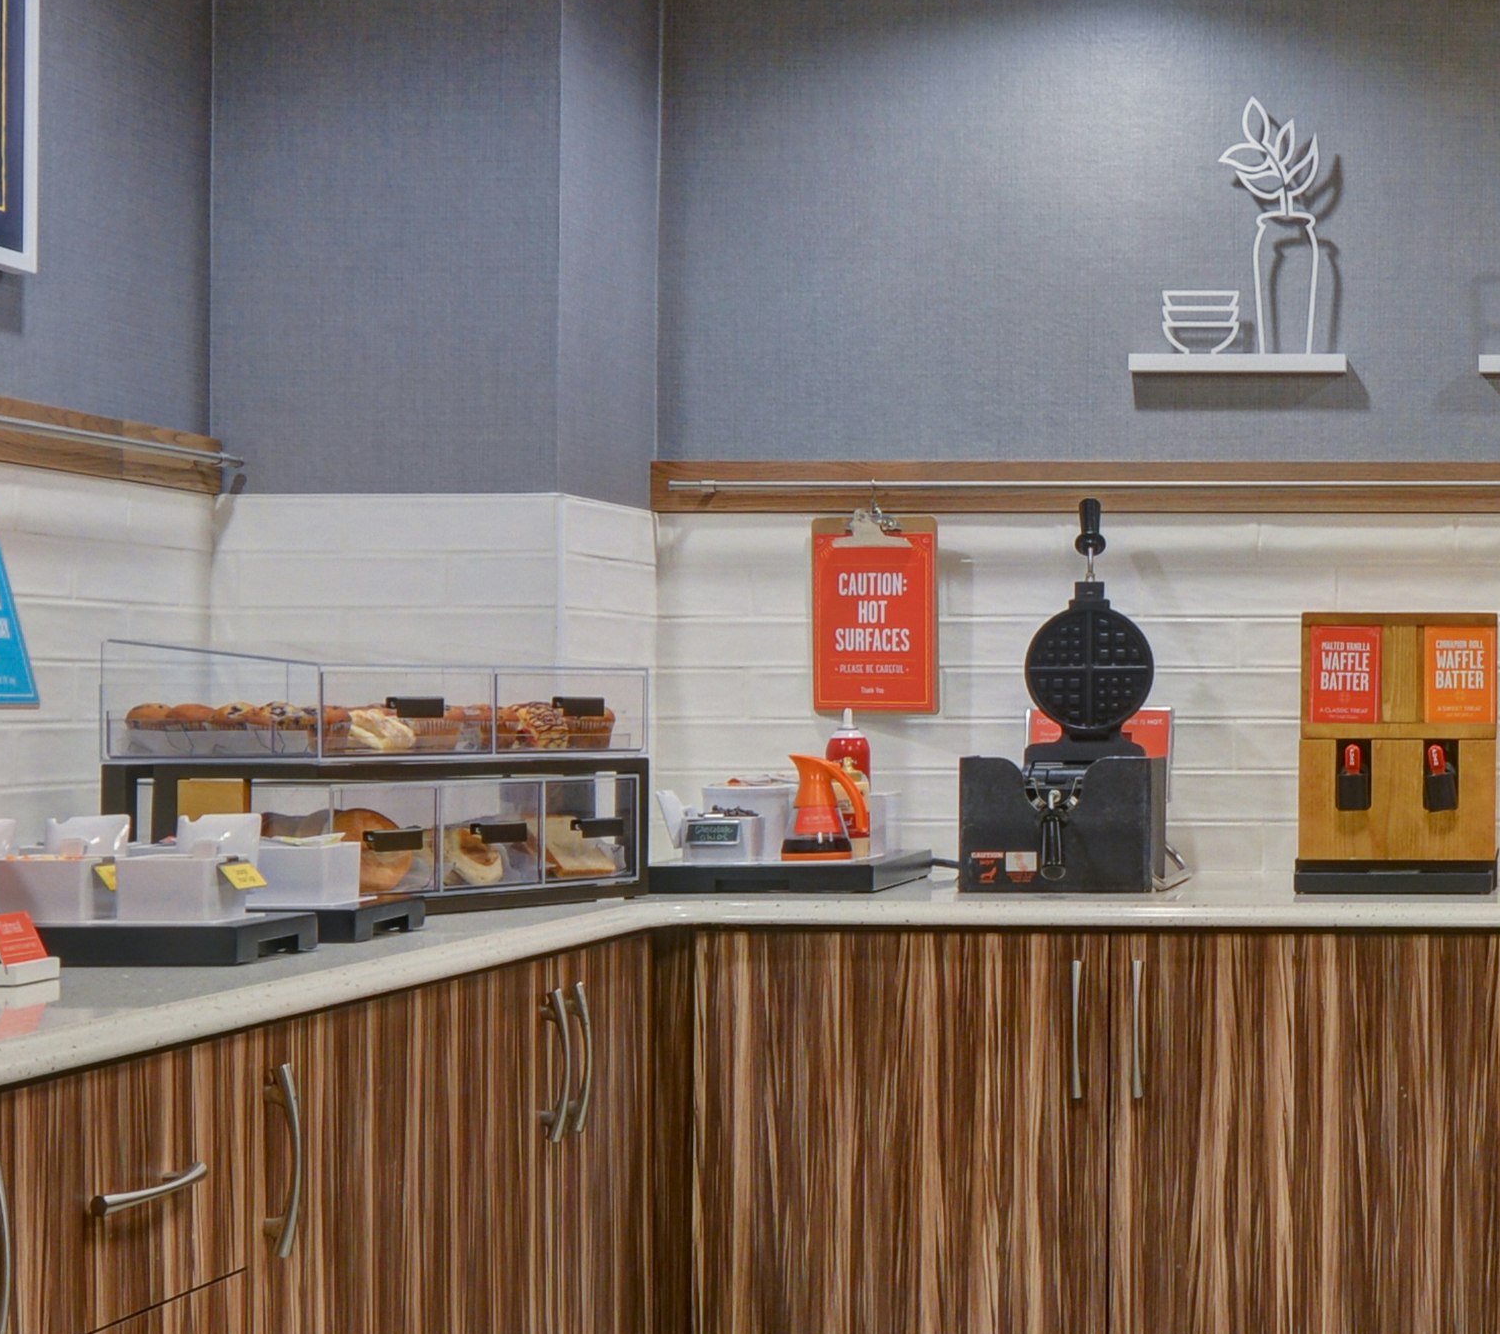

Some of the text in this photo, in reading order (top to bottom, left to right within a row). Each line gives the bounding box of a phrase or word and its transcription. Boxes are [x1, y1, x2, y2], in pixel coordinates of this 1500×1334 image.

[838, 572, 908, 596] CAUTION:
[857, 600, 888, 624] HOT
[835, 628, 910, 652] SURFACES
[839, 664, 904, 675] PLEASE BE CAREFUL
[1321, 651, 1370, 672] WAFFLE
[1436, 650, 1485, 670] WAFFLE
[1320, 672, 1369, 692] BATTER
[1435, 670, 1484, 690] BATTER
